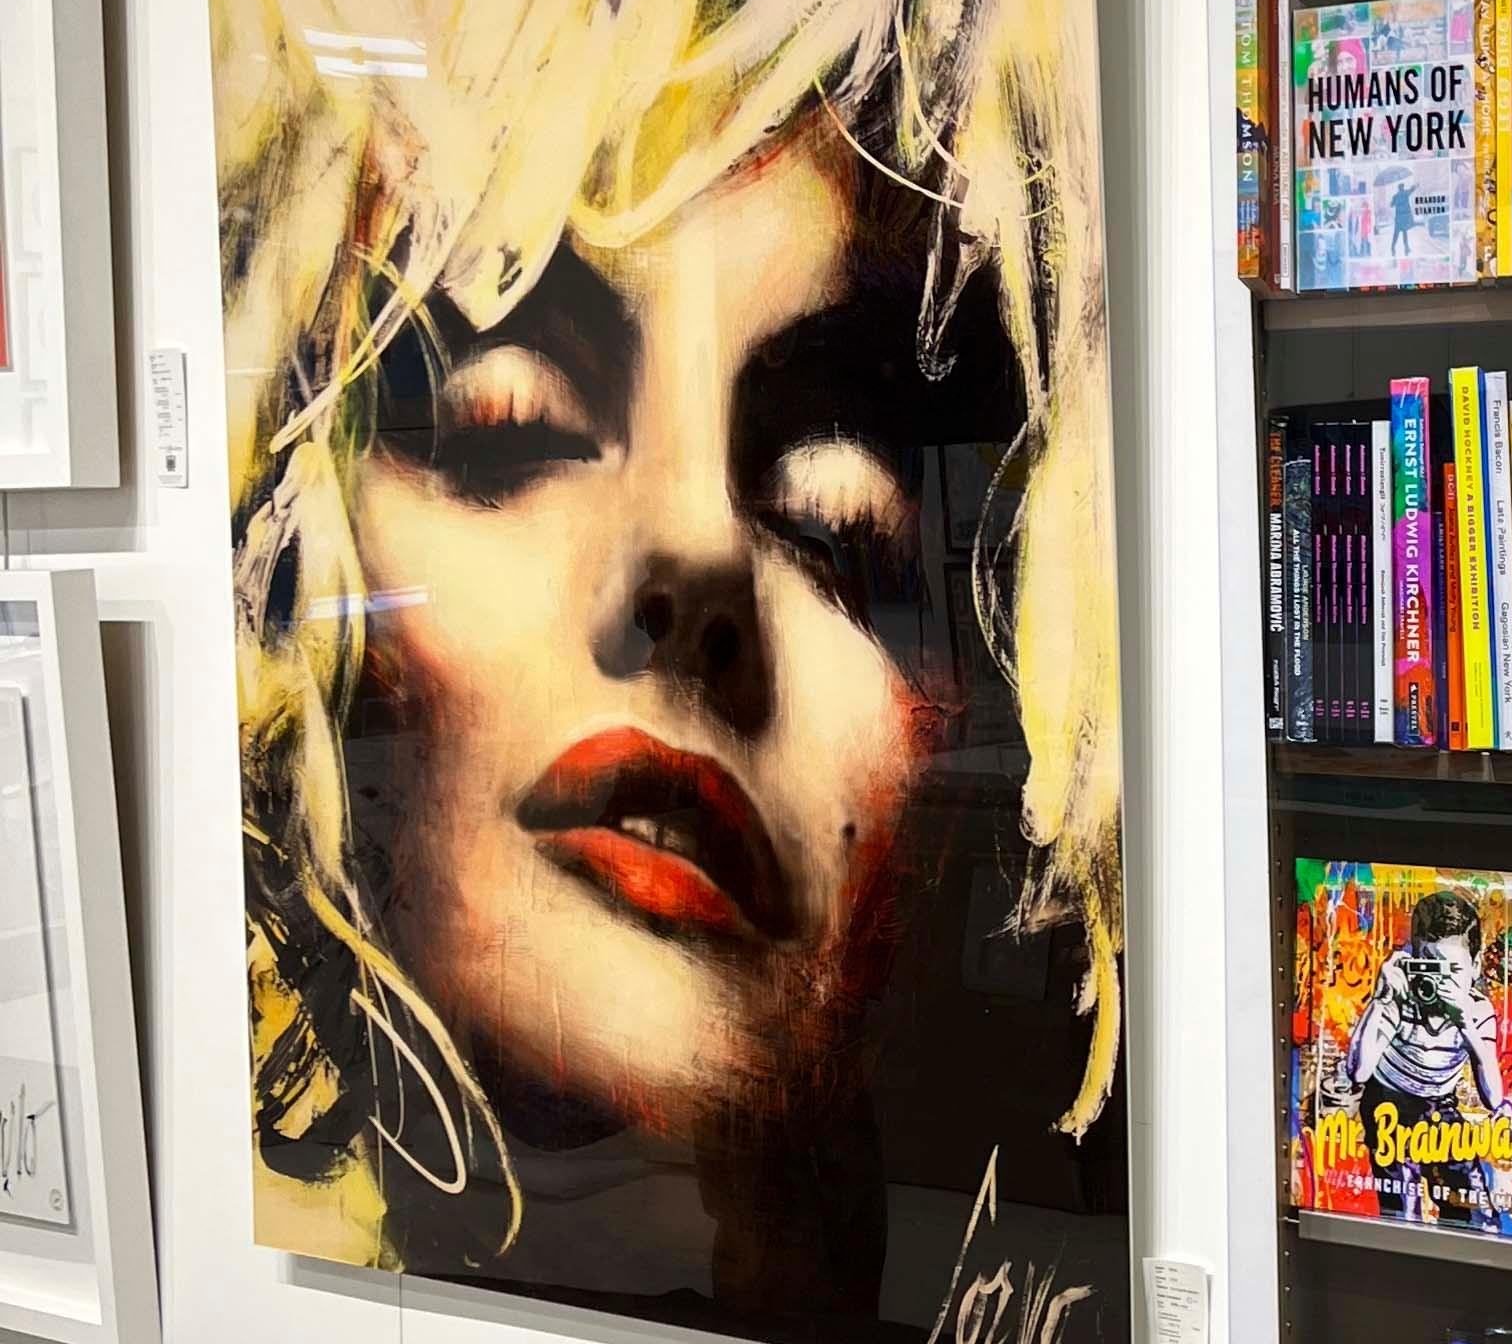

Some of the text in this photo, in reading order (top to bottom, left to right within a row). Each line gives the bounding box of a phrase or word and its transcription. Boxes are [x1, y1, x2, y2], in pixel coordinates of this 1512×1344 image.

[1308, 64, 1465, 113] HUMANS OF
[1309, 109, 1466, 159] NEW YORK
[1414, 195, 1446, 205] BRANDON
[1414, 205, 1446, 215] STANTON
[1403, 418, 1421, 663] ERNST LUDWIG KIRCHNER
[1303, 1108, 1364, 1178] Mr.
